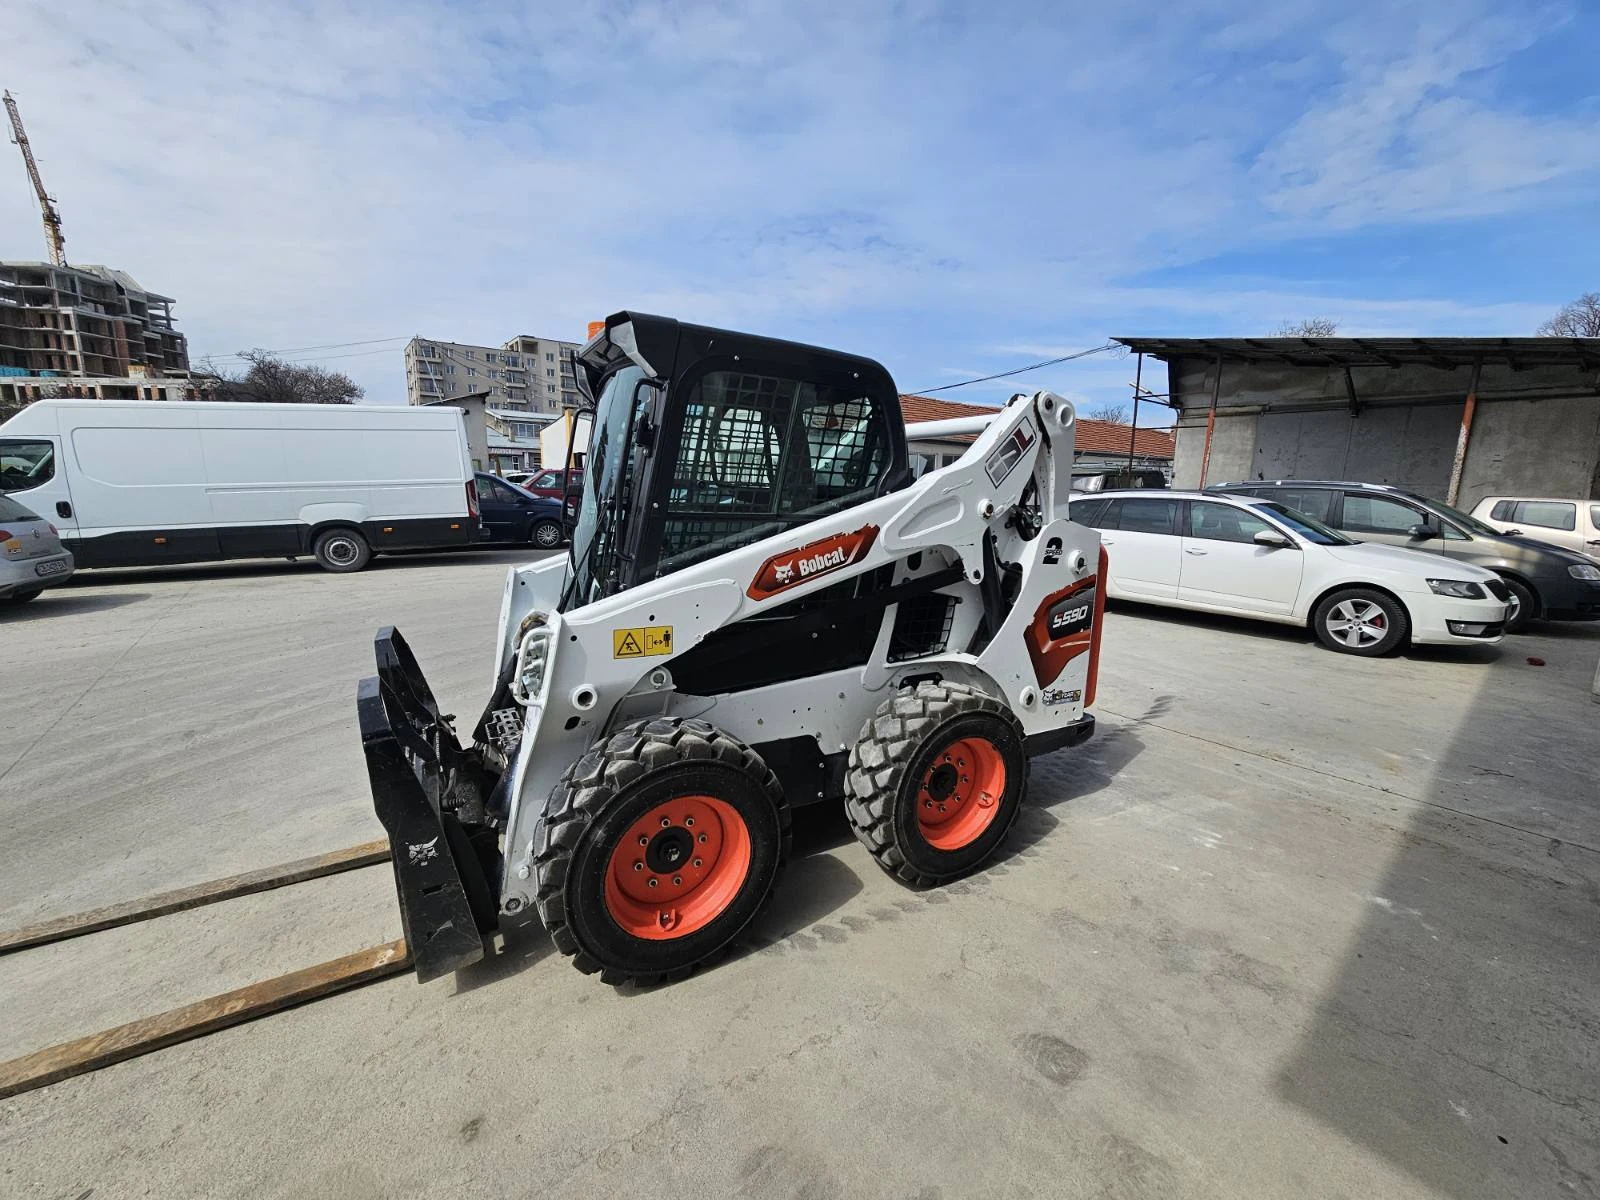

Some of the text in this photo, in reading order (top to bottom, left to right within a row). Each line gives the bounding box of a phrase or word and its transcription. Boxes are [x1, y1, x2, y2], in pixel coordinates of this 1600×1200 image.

[798, 546, 845, 576] Bobcat
[1043, 536, 1063, 564] 2
[1045, 548, 1063, 556] SPEED
[1052, 604, 1089, 628] S590
